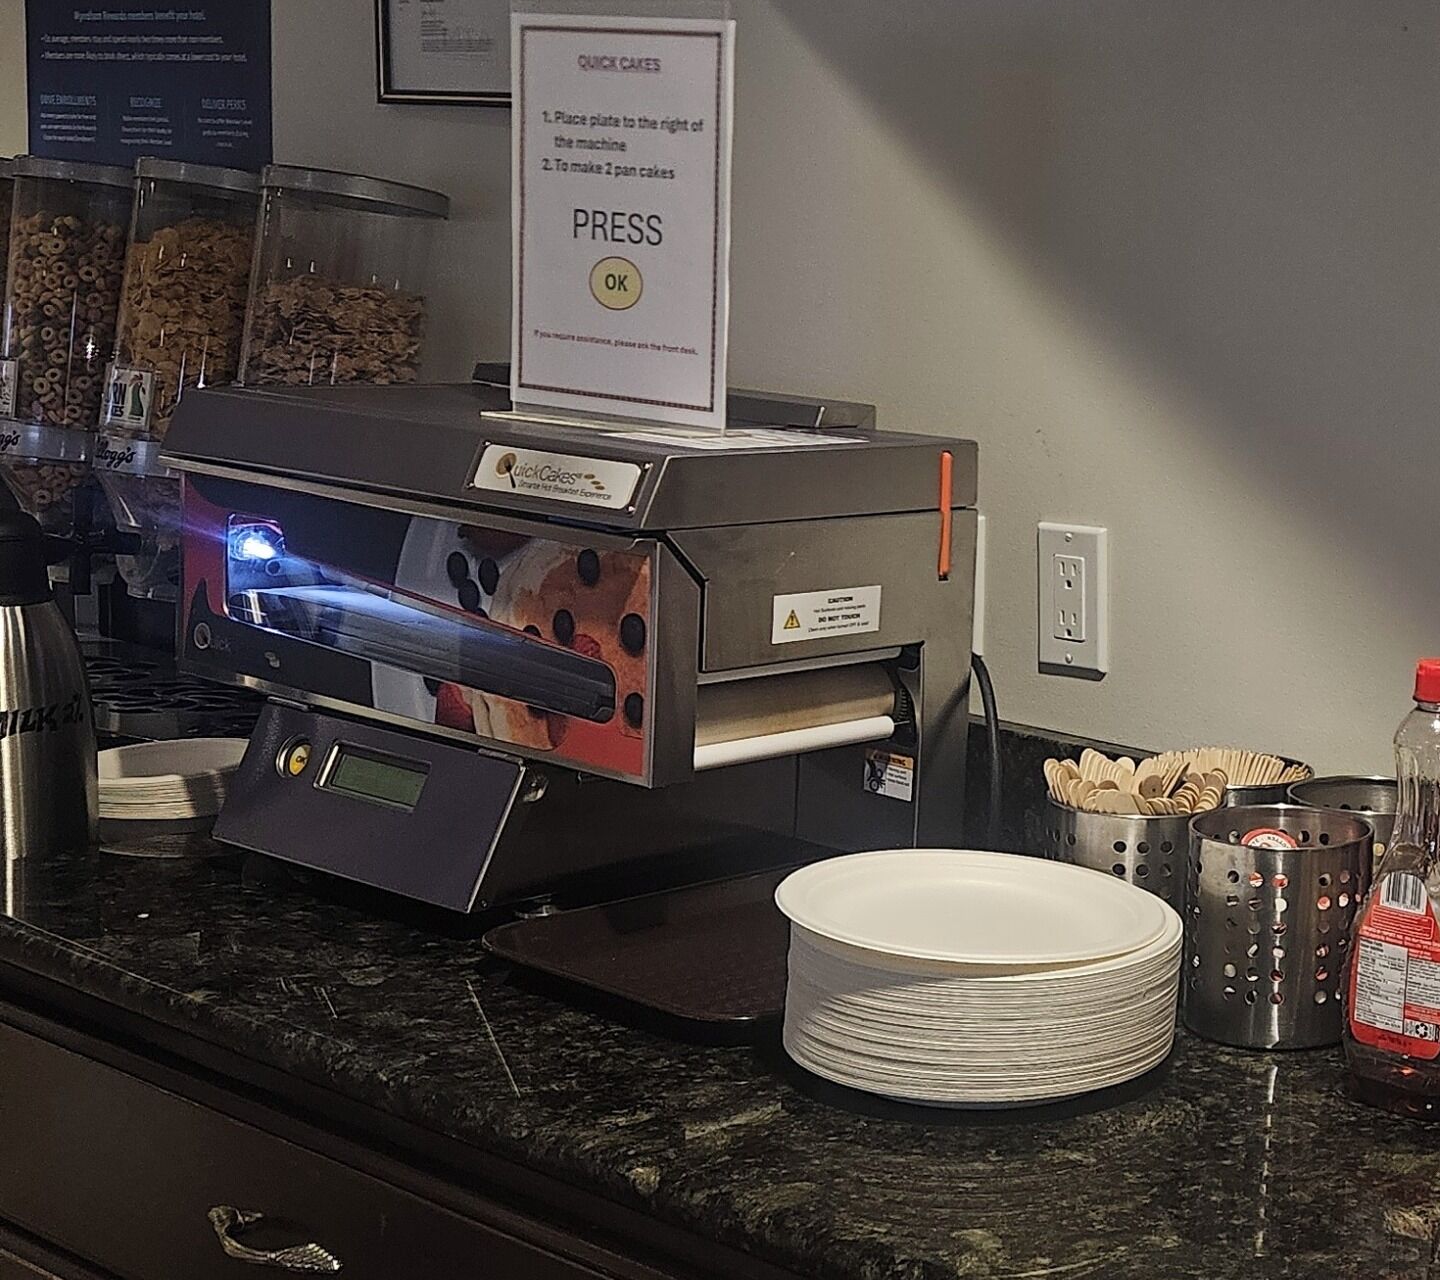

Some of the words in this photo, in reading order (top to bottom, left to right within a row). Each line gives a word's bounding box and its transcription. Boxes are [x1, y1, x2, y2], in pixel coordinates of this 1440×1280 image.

[577, 54, 618, 71] QUICK
[619, 56, 662, 72] CAKES
[542, 110, 553, 123] 1.
[554, 111, 587, 125] Place
[589, 113, 621, 128] plate
[623, 115, 635, 128] to
[638, 116, 657, 130] the
[660, 117, 689, 134] right
[691, 118, 704, 132] of
[554, 135, 573, 149] the
[576, 137, 627, 152] machine
[542, 158, 553, 171] 2.
[554, 158, 568, 172] To
[570, 160, 602, 174] make
[605, 162, 612, 175] 2
[614, 166, 637, 178] pan
[639, 165, 675, 180] cakes
[573, 208, 663, 246] PRESS
[604, 273, 628, 292] OK
[828, 596, 853, 604] CAUTION
